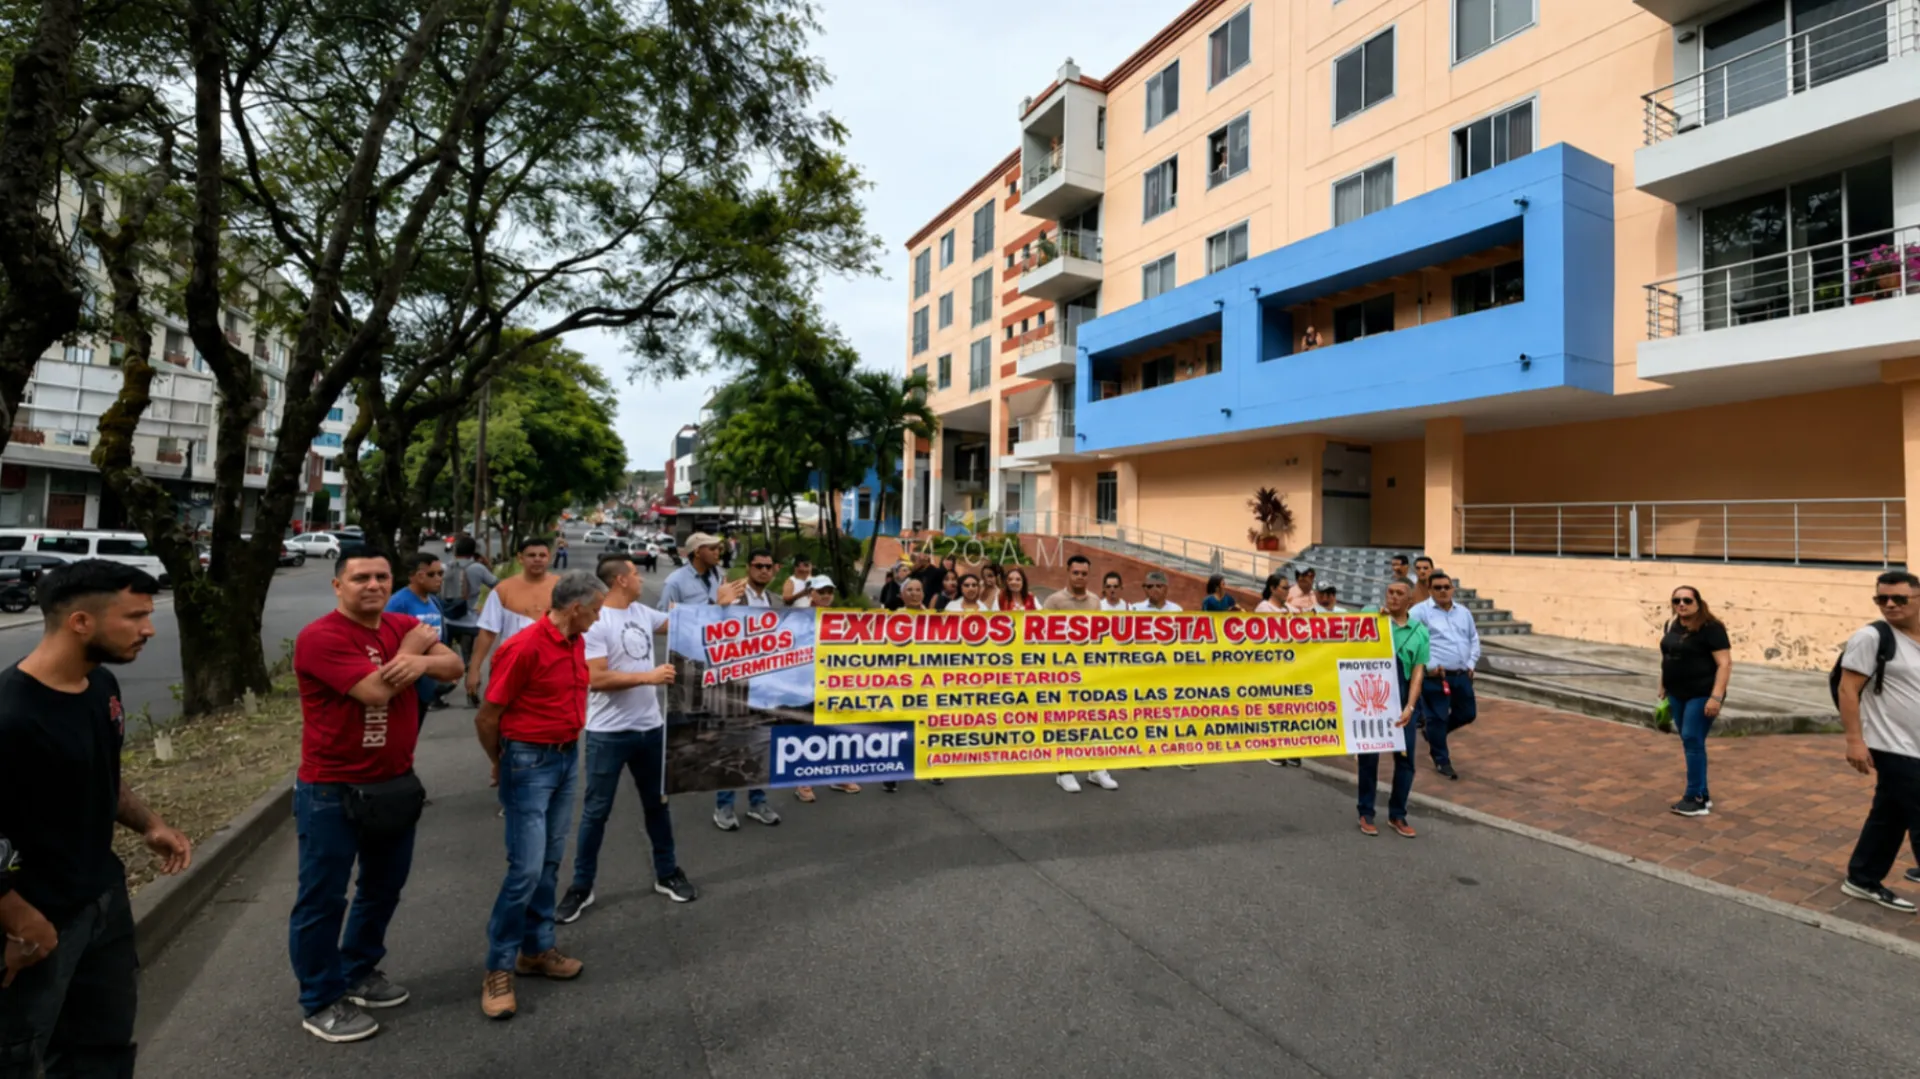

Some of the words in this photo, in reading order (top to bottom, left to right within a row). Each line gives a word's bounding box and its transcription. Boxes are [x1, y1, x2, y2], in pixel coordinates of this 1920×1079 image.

[704, 618, 741, 645] NO
[746, 611, 778, 635] LO
[819, 613, 1014, 645] EXIGIMOS
[1024, 615, 1216, 644] RESPUESTA
[1223, 616, 1379, 643] CONCRETA
[707, 630, 793, 664] VAMOS
[1021, 652, 1045, 666] EN
[1053, 652, 1077, 665] LA
[1083, 651, 1167, 665] ENTREGA
[1173, 650, 1205, 664] DEL
[1212, 649, 1295, 663] PROYECTO
[1339, 660, 1392, 670] PROYECTO
[703, 670, 717, 686] A
[921, 673, 935, 687] A
[943, 671, 1081, 687] PROPIETARIOS
[902, 694, 928, 708] DE
[936, 691, 1029, 707] ENTREGA
[1036, 690, 1061, 704] EN
[1068, 688, 1128, 703] TODAS
[1134, 687, 1168, 701] LAS
[1174, 685, 1231, 700] ZONAS
[1236, 684, 1313, 698] COMUNES
[1003, 711, 1038, 725] CON
[1044, 708, 1128, 722] EMPRESAS
[1133, 704, 1239, 720] PRESTADORAS
[1245, 703, 1262, 716] DE
[1268, 701, 1337, 715] SERVICIOS
[1043, 727, 1138, 743] DESFALCO
[1145, 725, 1168, 739] EN
[1175, 724, 1197, 738] LA
[1204, 718, 1337, 736] ADMINISTRACIÓN
[776, 731, 908, 775] pomar
[1056, 744, 1143, 760] PROVISIONAL
[1149, 745, 1156, 754] A
[1161, 741, 1203, 754] CARGO
[1206, 740, 1222, 751] DE
[1226, 740, 1241, 750] LA
[1245, 735, 1340, 749] CONSTRUCTORA)
[794, 761, 905, 777] CONSTRUCTORA
